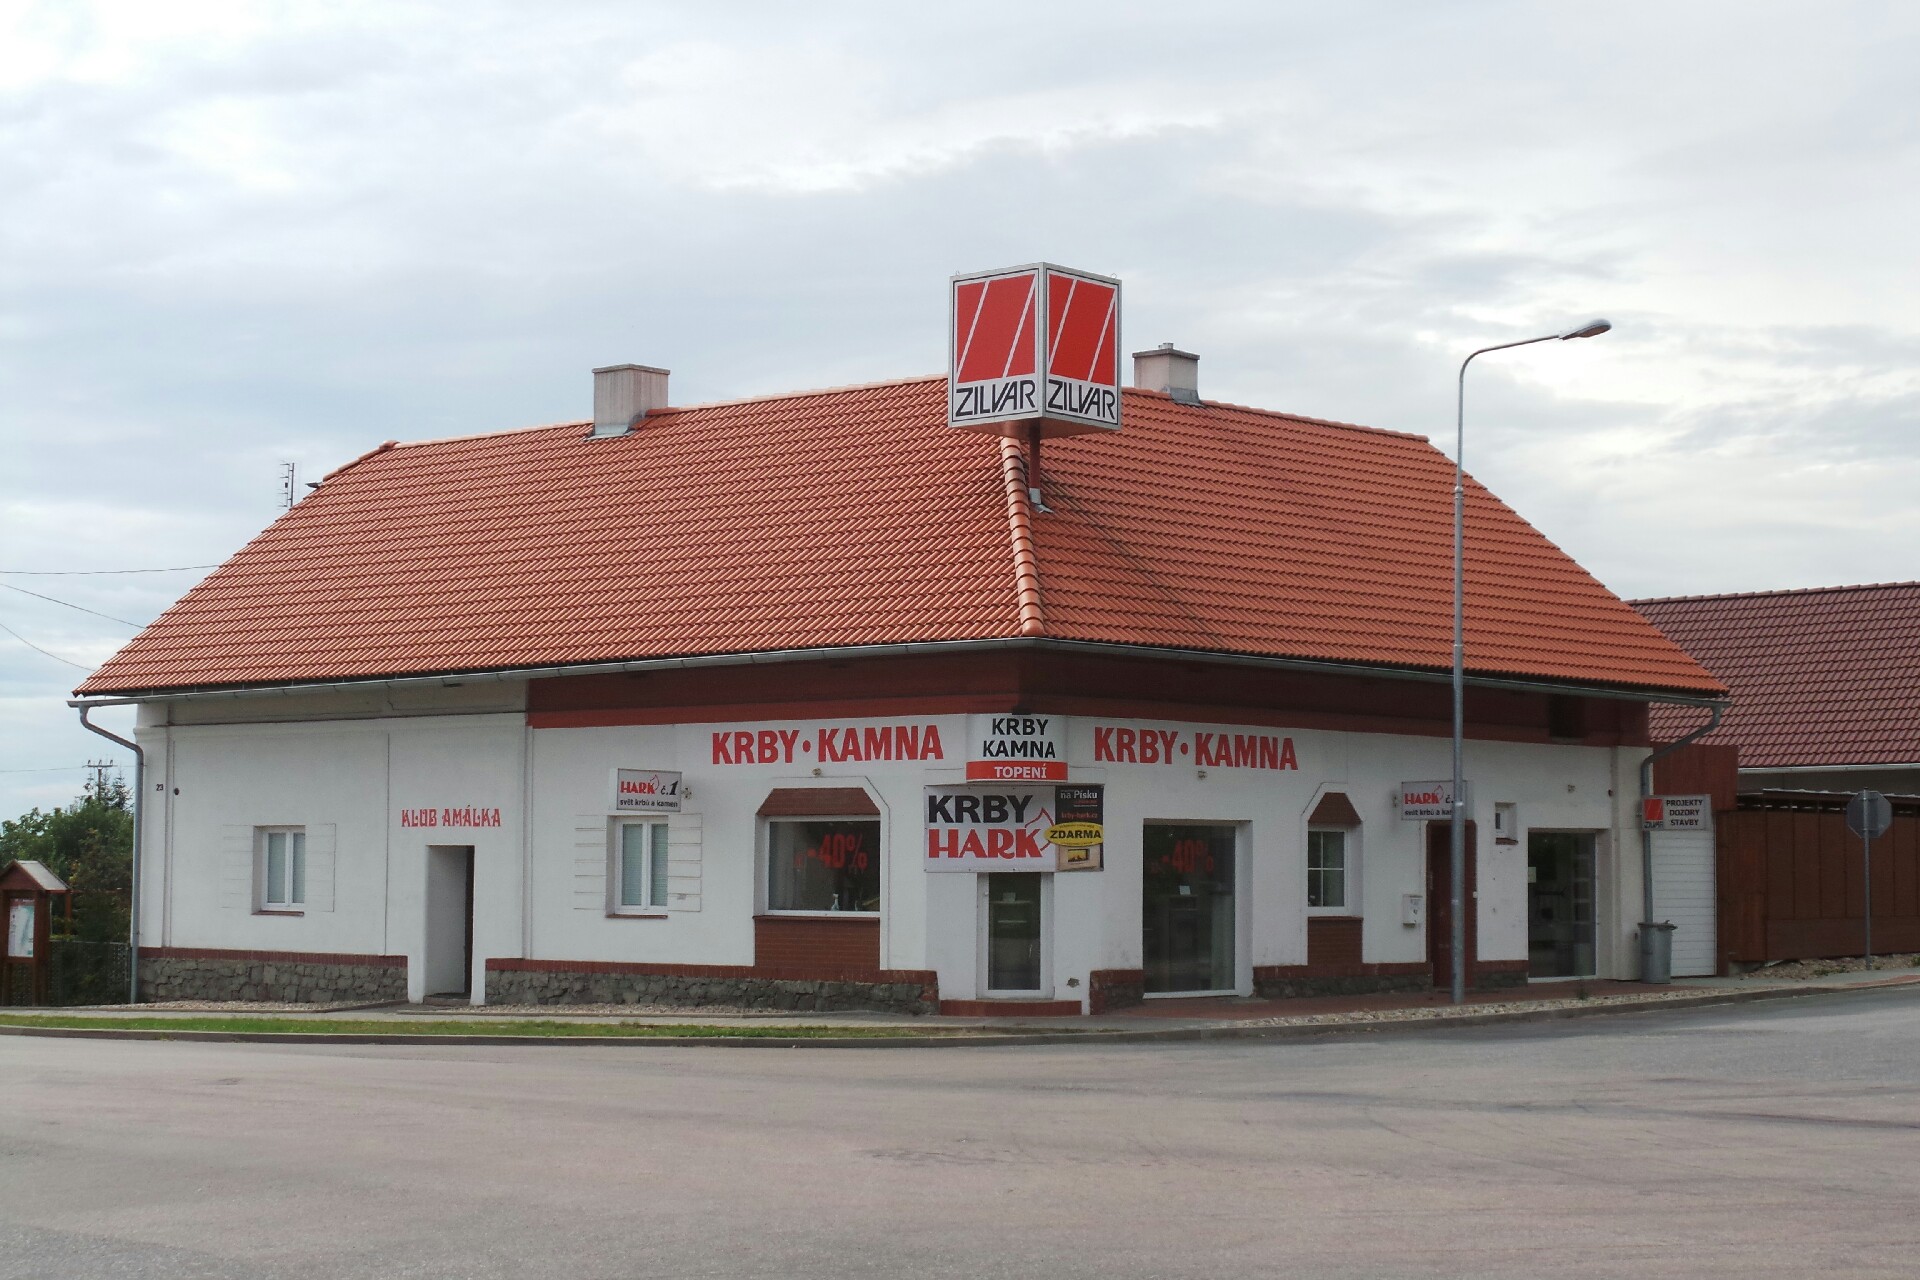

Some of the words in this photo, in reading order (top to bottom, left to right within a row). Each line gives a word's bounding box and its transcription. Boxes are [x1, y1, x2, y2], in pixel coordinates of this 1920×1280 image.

[955, 379, 1036, 417] ZILVAR
[1047, 379, 1116, 420] ZILVAR
[992, 718, 1049, 735] KRBY
[712, 729, 800, 765] KRBY
[818, 724, 944, 763] KAMNA
[982, 740, 1056, 759] KAMNA
[1094, 726, 1179, 765] KRBY
[1195, 732, 1299, 771] KAMNA
[994, 763, 1047, 779] TOPENÍ
[620, 781, 656, 794] HARK
[1060, 791, 1072, 799] na
[1404, 792, 1441, 804] HARK
[1666, 799, 1703, 807] PROJEKTY
[401, 808, 437, 828] KLUB
[442, 804, 501, 828] AMÁLKA
[928, 795, 1034, 824] KRBY
[928, 828, 1043, 860] HARK
[1050, 830, 1102, 839] ZDARMA
